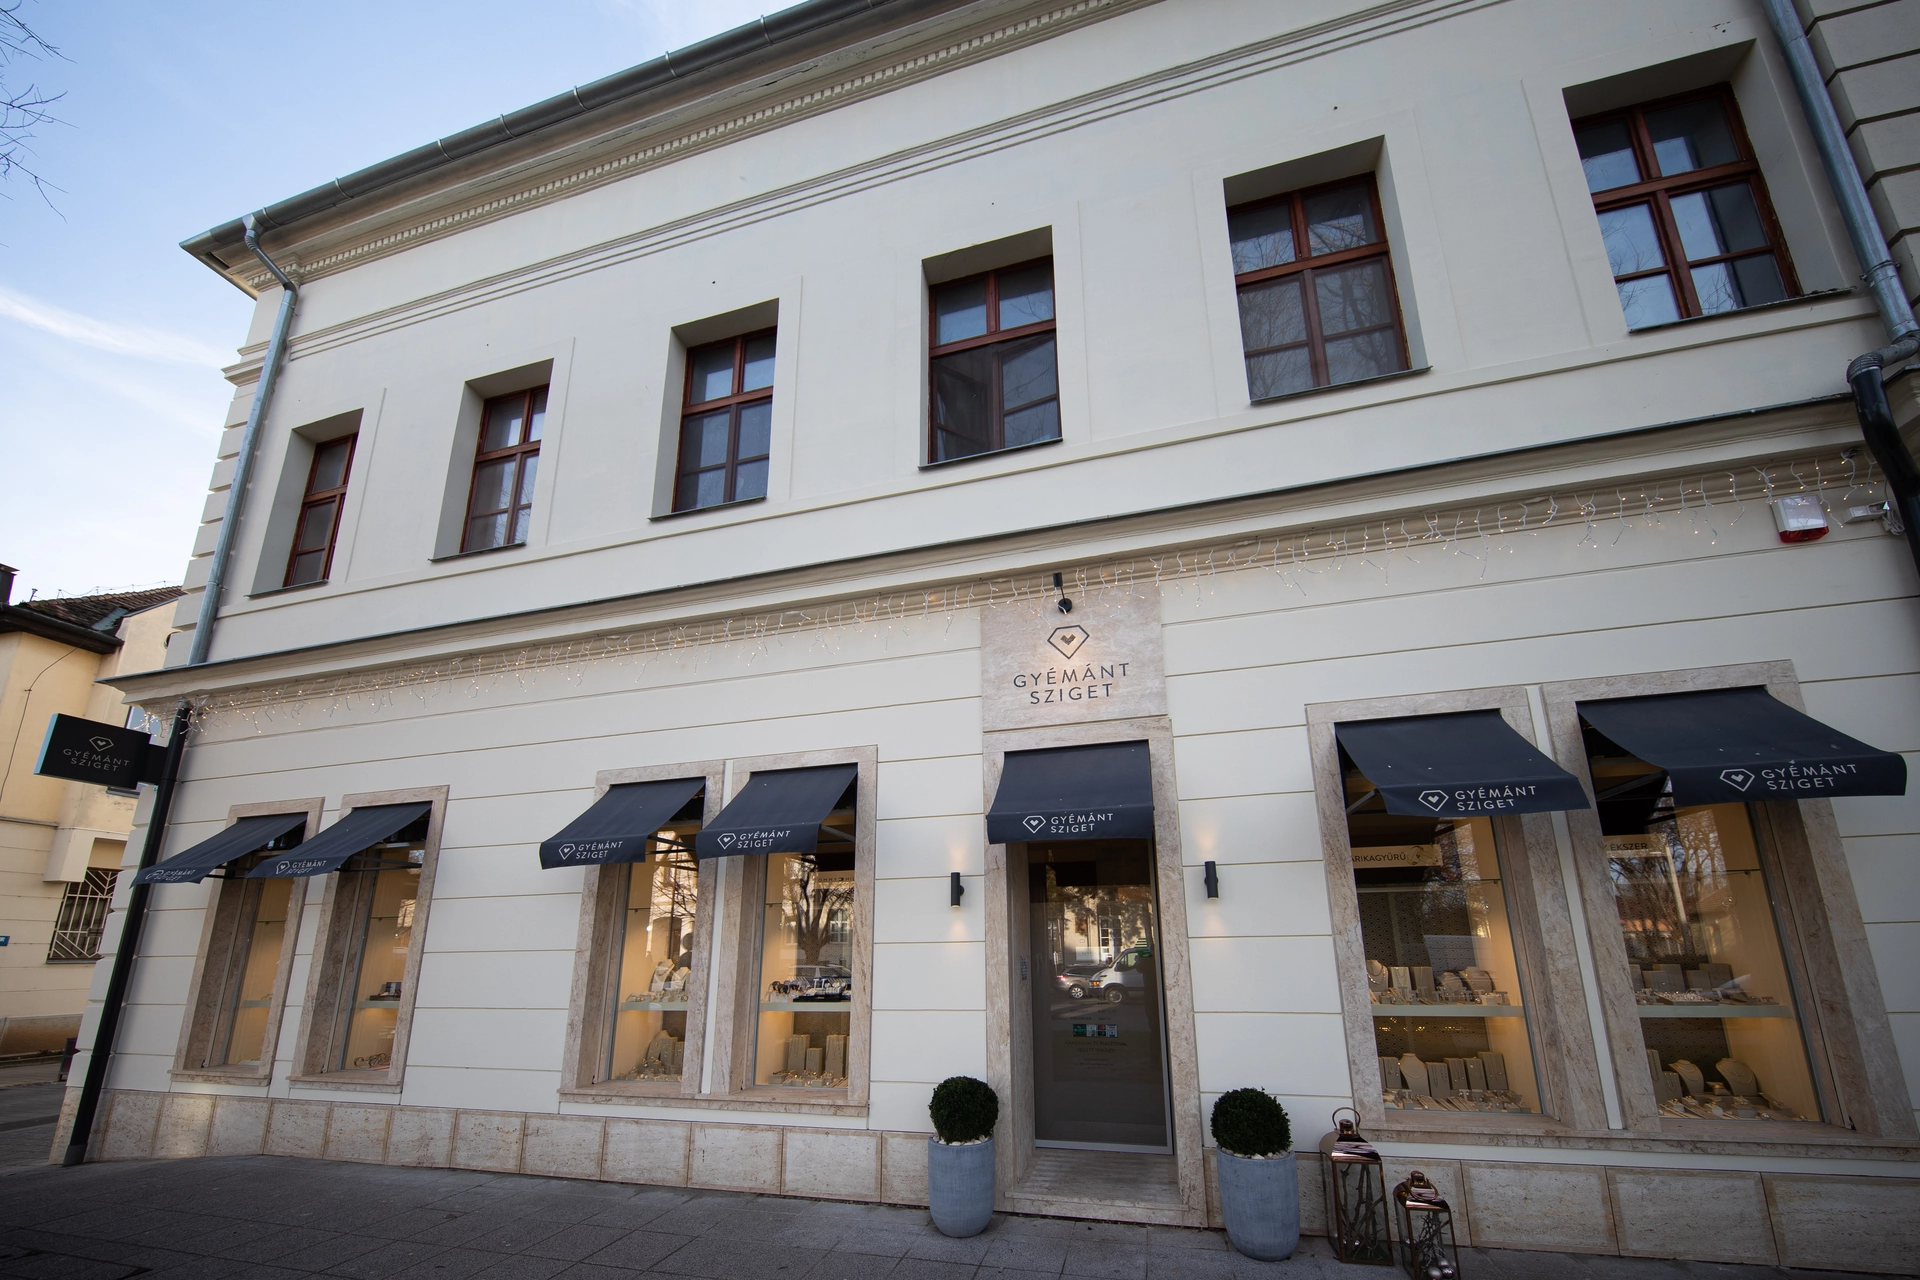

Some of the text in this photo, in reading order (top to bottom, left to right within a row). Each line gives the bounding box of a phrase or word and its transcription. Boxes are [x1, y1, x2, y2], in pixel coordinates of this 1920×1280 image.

[1013, 662, 1129, 688] GYÉMÁNT
[1030, 683, 1113, 705] SZIGET
[63, 748, 130, 767] GYÉMÁNT
[70, 757, 119, 772] SZIGET
[1761, 763, 1857, 779] GYÉMÁNT
[1766, 777, 1834, 791] SZIGET
[1454, 785, 1536, 800] GYÉMÁNT
[1456, 799, 1515, 811] SZIGET
[1050, 812, 1114, 825] GYÉMÁNT
[1050, 823, 1095, 834] SZIGET
[739, 830, 791, 840] GYÉMÁNT
[578, 841, 623, 851] GYÉMÁNT
[737, 839, 774, 849] SZIGET
[1610, 842, 1648, 851] ÉKSZER
[576, 850, 609, 860] SZIGET
[292, 860, 327, 869] GYÉMÁNT
